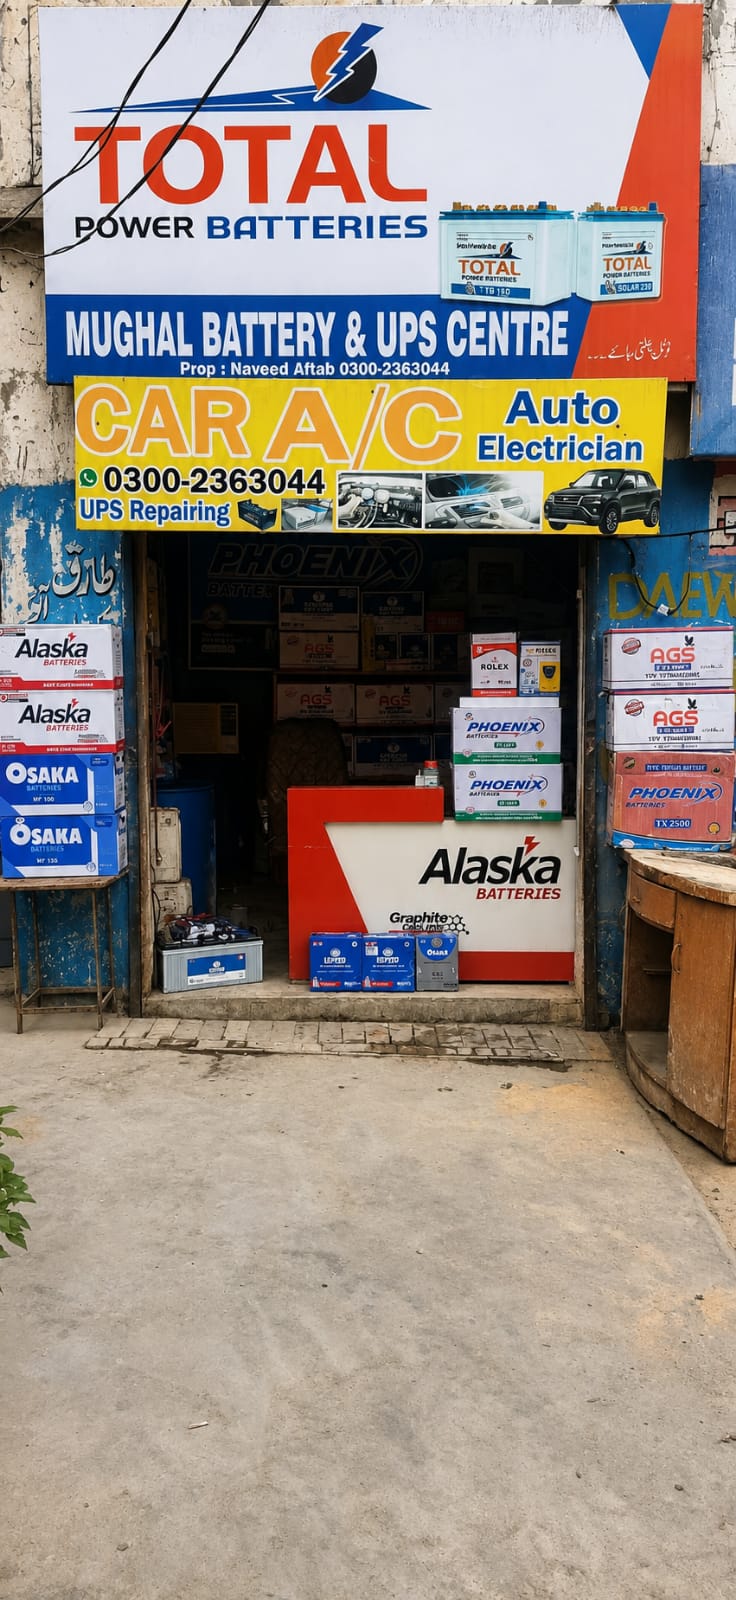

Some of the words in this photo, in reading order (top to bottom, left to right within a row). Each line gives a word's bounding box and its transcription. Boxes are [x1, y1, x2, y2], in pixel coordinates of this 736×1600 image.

[74, 123, 428, 205] TOTAL
[75, 216, 194, 239] POWER
[206, 214, 428, 240] BATTERIES
[458, 259, 521, 276] TOTAL
[602, 256, 652, 272] TOTAL
[65, 310, 194, 357] MUGHAL
[202, 311, 336, 357] BATTERY
[344, 311, 367, 357] &
[376, 310, 437, 357] UPS
[446, 310, 569, 357] CENTRE
[180, 362, 216, 378] Prop
[230, 362, 289, 376] Naveed
[293, 362, 335, 376] Aftab
[339, 362, 450, 376] 0300-2363044
[503, 388, 621, 428] Auto
[74, 383, 252, 458] CAR
[262, 383, 463, 471] A/C
[477, 433, 644, 464] Electrician
[103, 466, 327, 496] 0300-2363044
[79, 498, 123, 521] UPS
[129, 499, 231, 527] Repairing
[52, 540, 115, 597] طارق
[208, 541, 418, 580] PHOENIX
[14, 637, 89, 658] Alaska
[650, 647, 696, 663] AGS
[480, 663, 509, 671] ROLEX
[300, 693, 333, 705] AGS
[17, 703, 91, 724] Alaska
[653, 710, 699, 727] AGS
[46, 724, 89, 732] BATTERIES
[466, 721, 541, 732] PHOENIX
[5, 762, 79, 785] OSAKA
[470, 779, 545, 791] PHOENIX
[628, 787, 718, 799] PHOENIX
[656, 819, 667, 827] TX
[669, 819, 691, 827] 2500
[418, 846, 562, 885] Alaska
[476, 887, 562, 900] BATTERIES
[389, 911, 449, 929] Graphite
